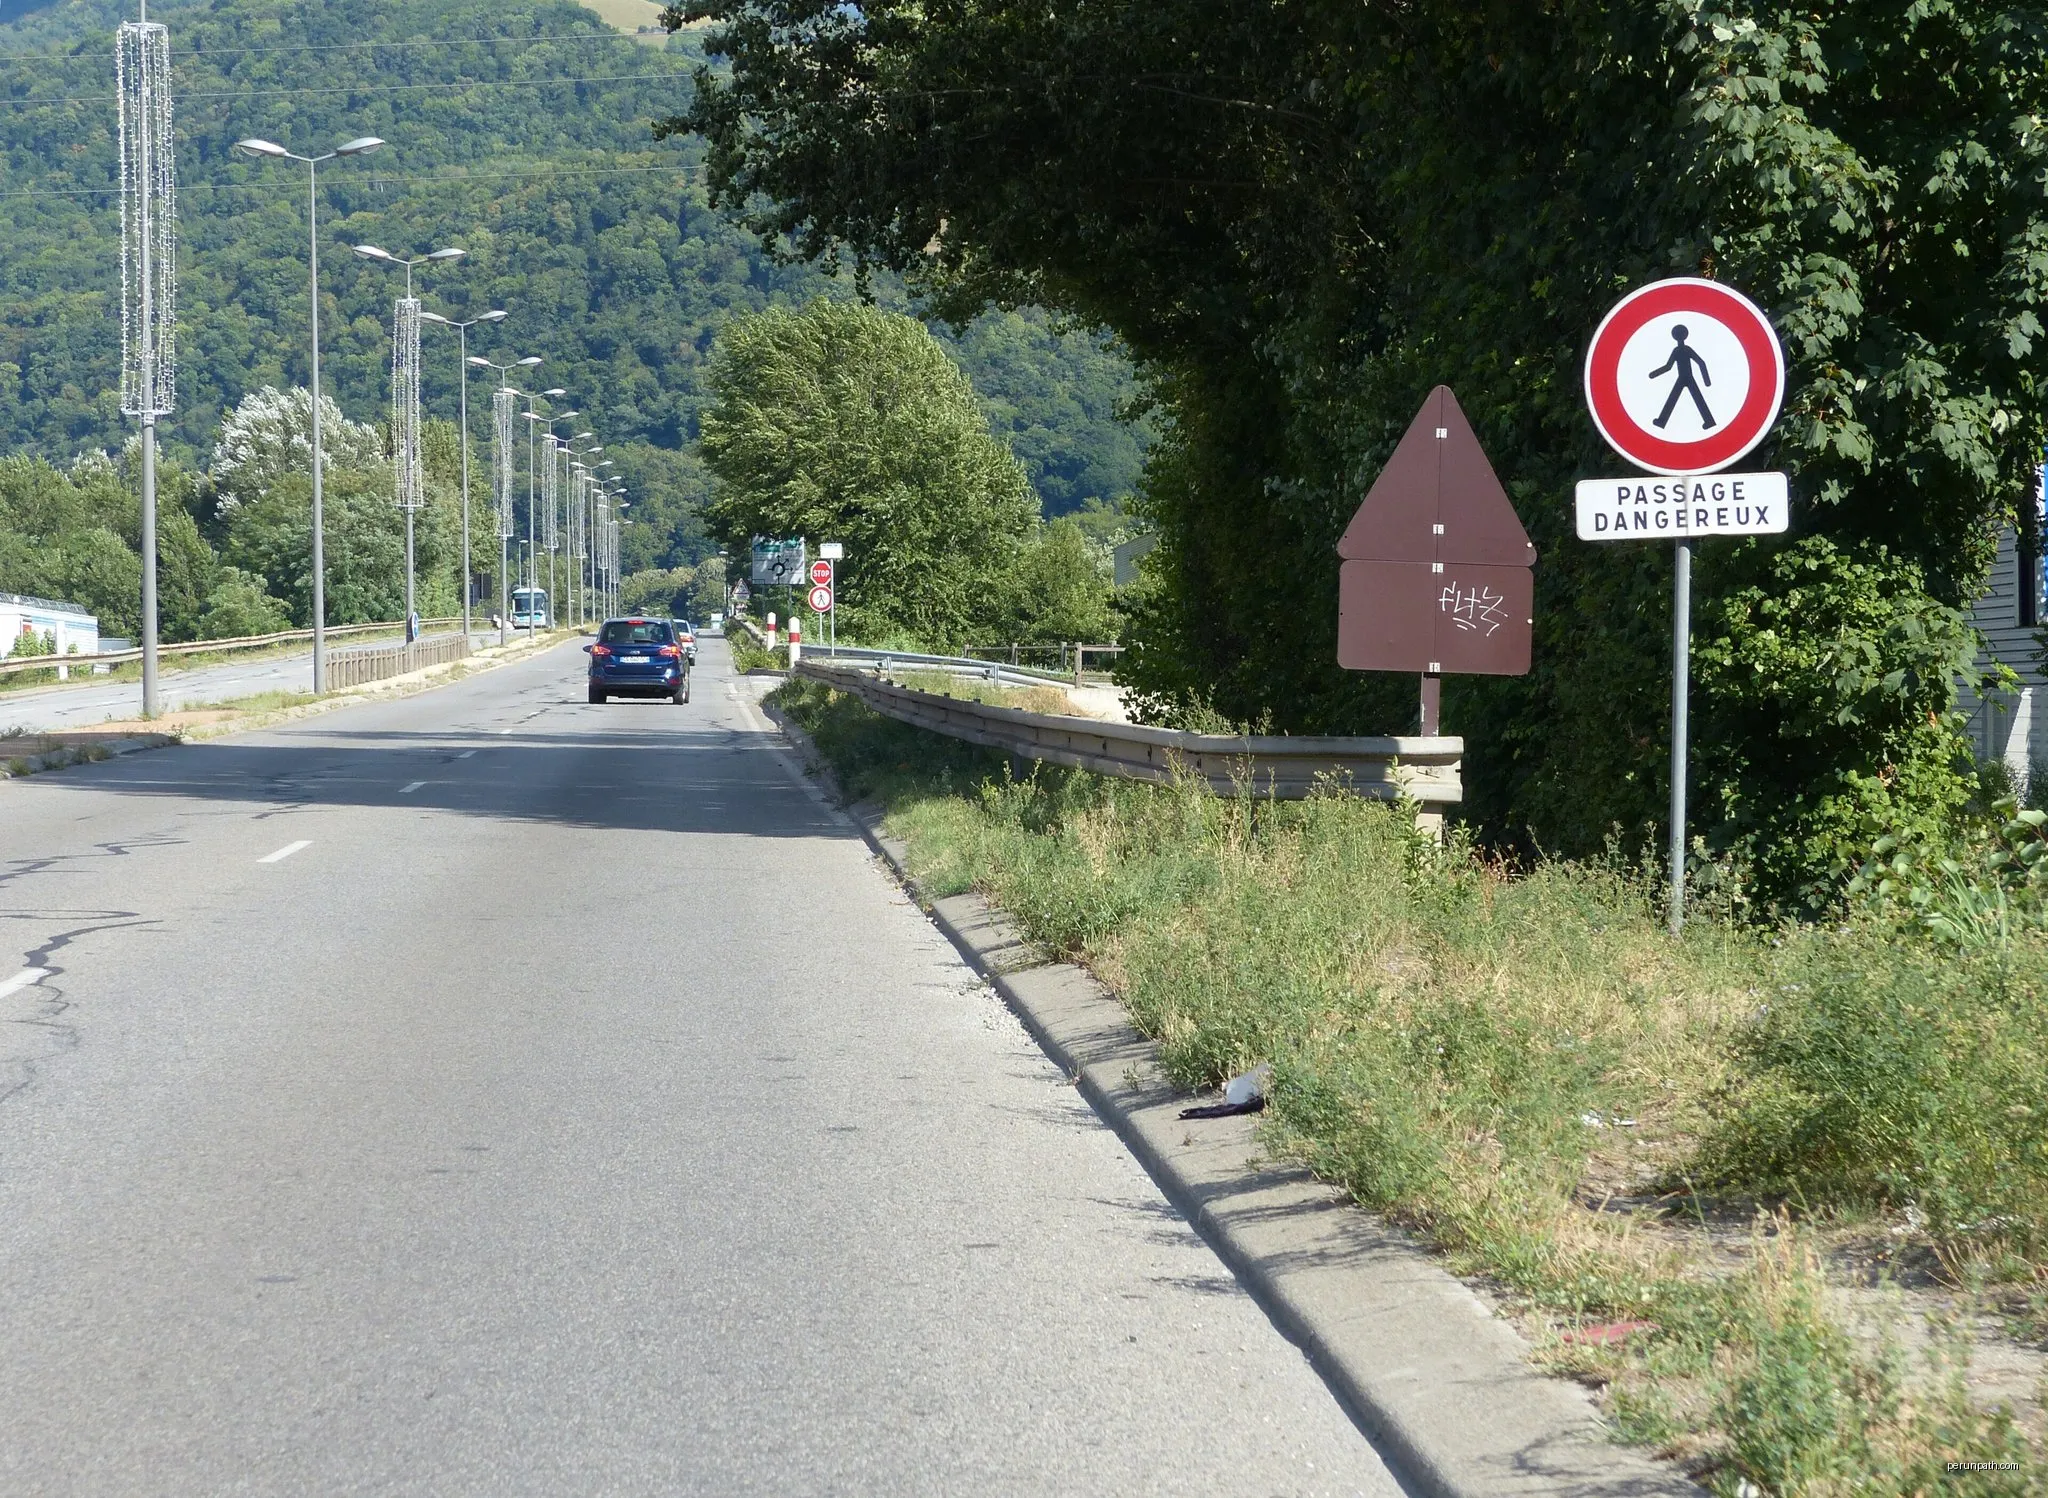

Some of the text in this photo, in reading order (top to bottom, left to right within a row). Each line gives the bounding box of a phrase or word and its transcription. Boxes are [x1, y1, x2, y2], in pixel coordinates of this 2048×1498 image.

[1617, 481, 1745, 505] PASSAGE
[1595, 506, 1769, 532] DANGEREUX
[813, 569, 830, 578] STOP
